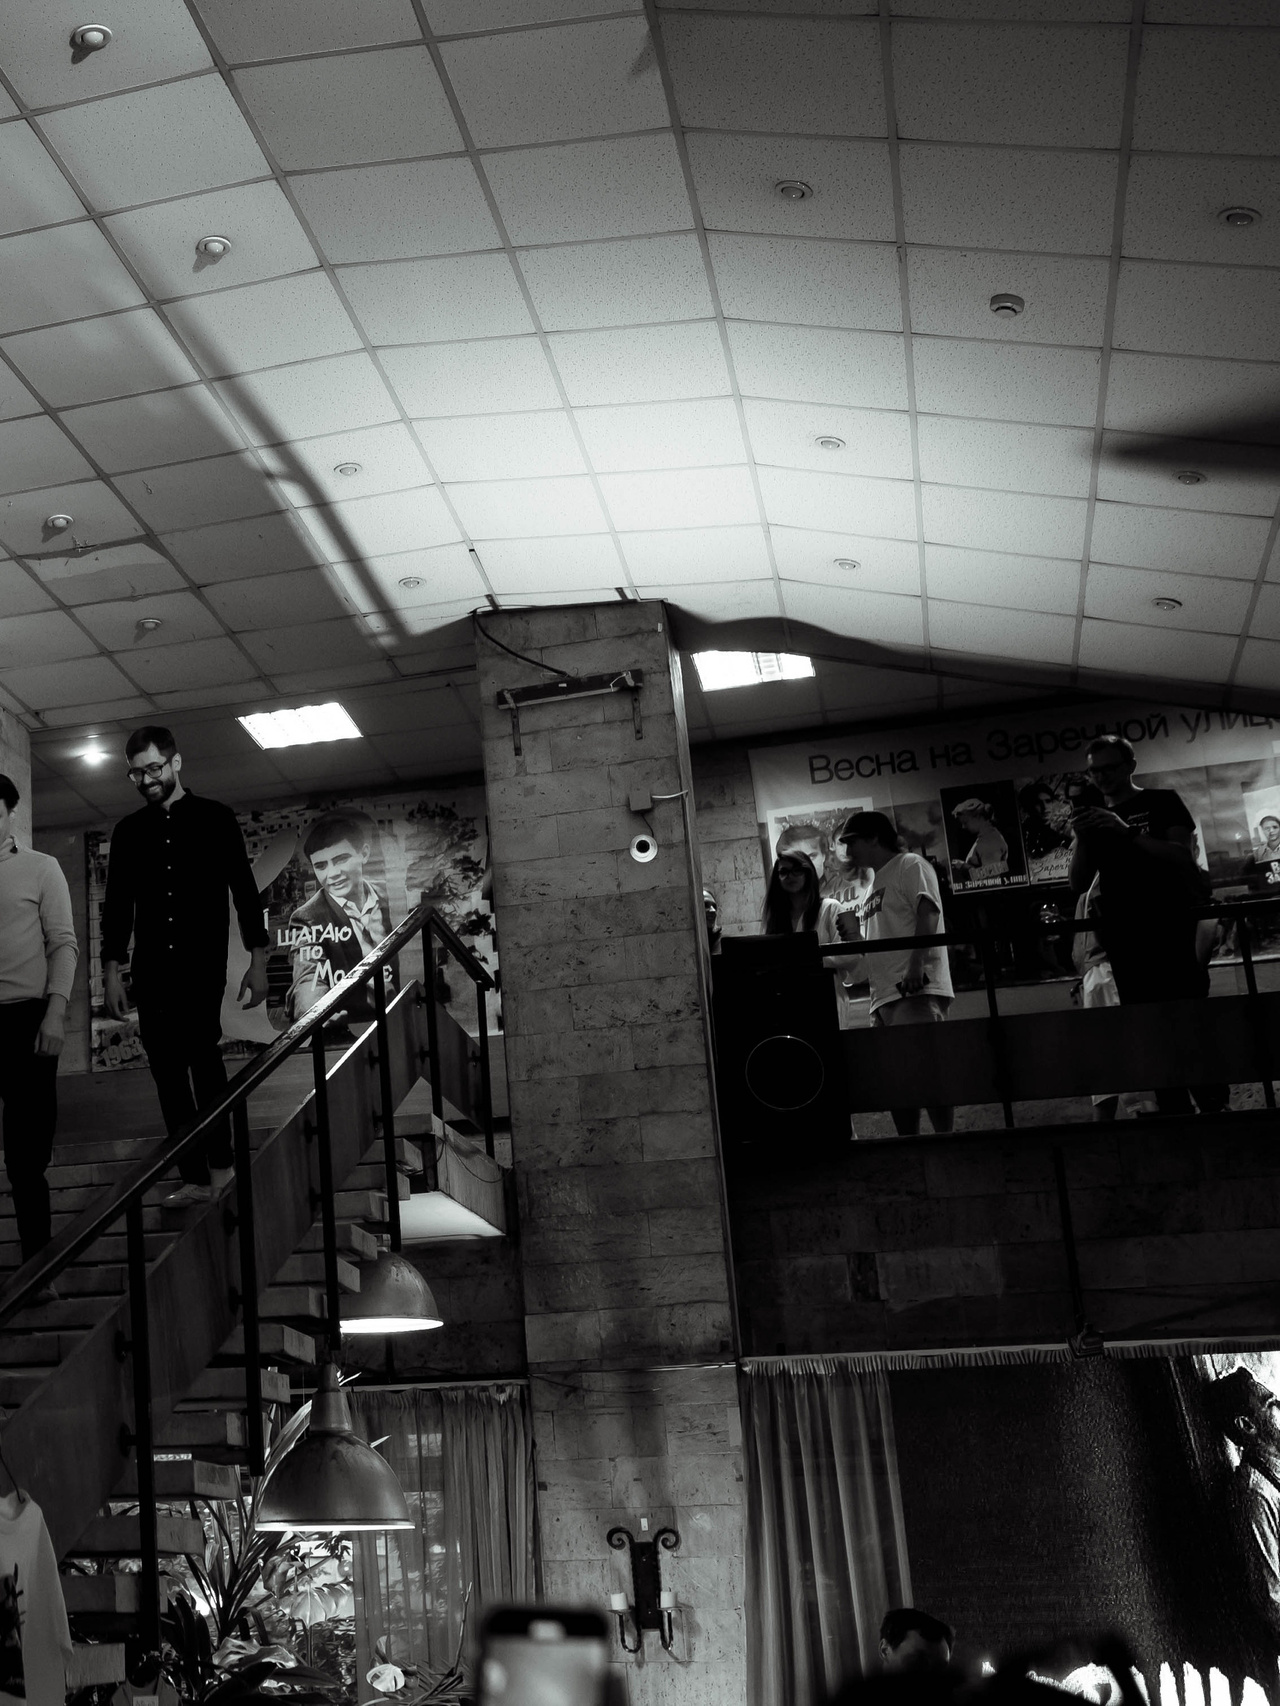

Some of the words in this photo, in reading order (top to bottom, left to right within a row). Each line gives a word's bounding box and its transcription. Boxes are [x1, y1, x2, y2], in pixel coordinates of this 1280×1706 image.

[808, 748, 919, 784] Весна
[929, 742, 974, 768] на
[987, 712, 1169, 762] Заречной
[1180, 711, 1280, 743] улиц
[277, 922, 352, 947] ШАГАЮ
[299, 945, 324, 962] ПО
